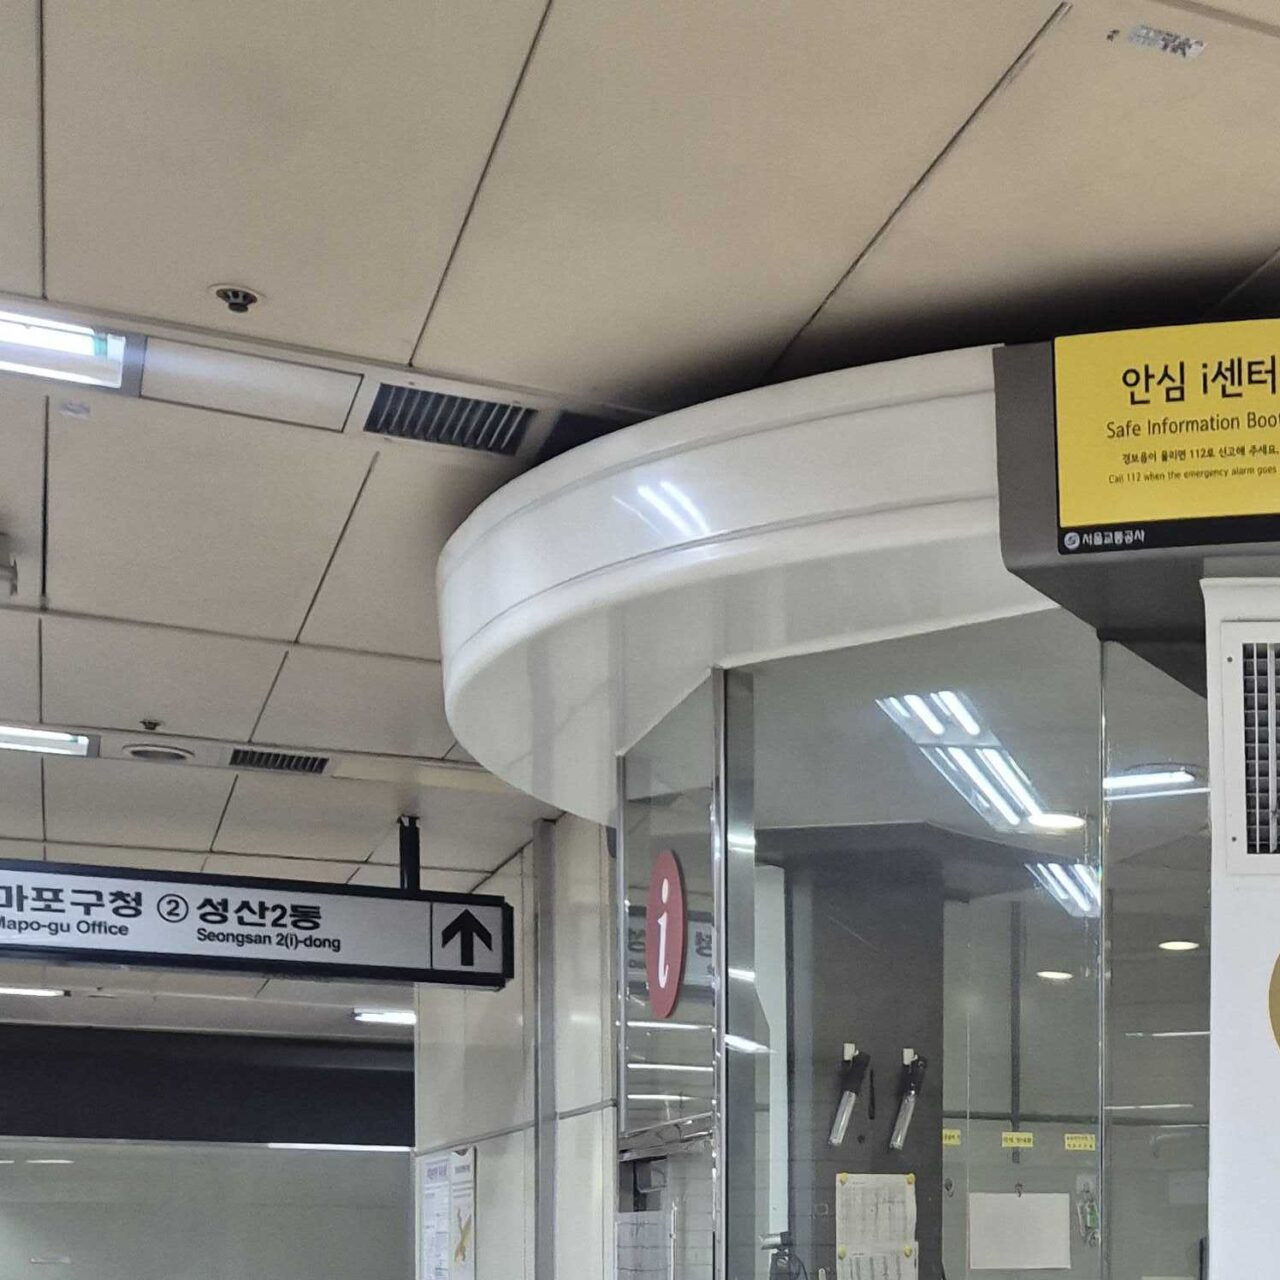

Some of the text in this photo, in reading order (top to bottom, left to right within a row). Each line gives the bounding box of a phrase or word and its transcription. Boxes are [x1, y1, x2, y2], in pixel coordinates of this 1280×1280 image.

[1122, 355, 1277, 405] 안심 i센터
[1107, 420, 1141, 439] Safe
[1148, 413, 1240, 436] Information
[1190, 447, 1215, 459] 112로
[1109, 474, 1124, 484] Call
[1127, 472, 1141, 483] 112
[1144, 472, 1165, 482] when
[1168, 471, 1181, 480] the
[1184, 468, 1229, 480] emergency
[1231, 466, 1255, 475] alarm
[1257, 465, 1277, 476] goes
[1082, 530, 1145, 546] 서울교통공사
[0, 885, 143, 918] 마포구청
[197, 898, 322, 930] 성산2동
[76, 919, 129, 936] Office
[197, 928, 272, 947] Seongsan
[276, 932, 341, 953] 2(i)-dong
